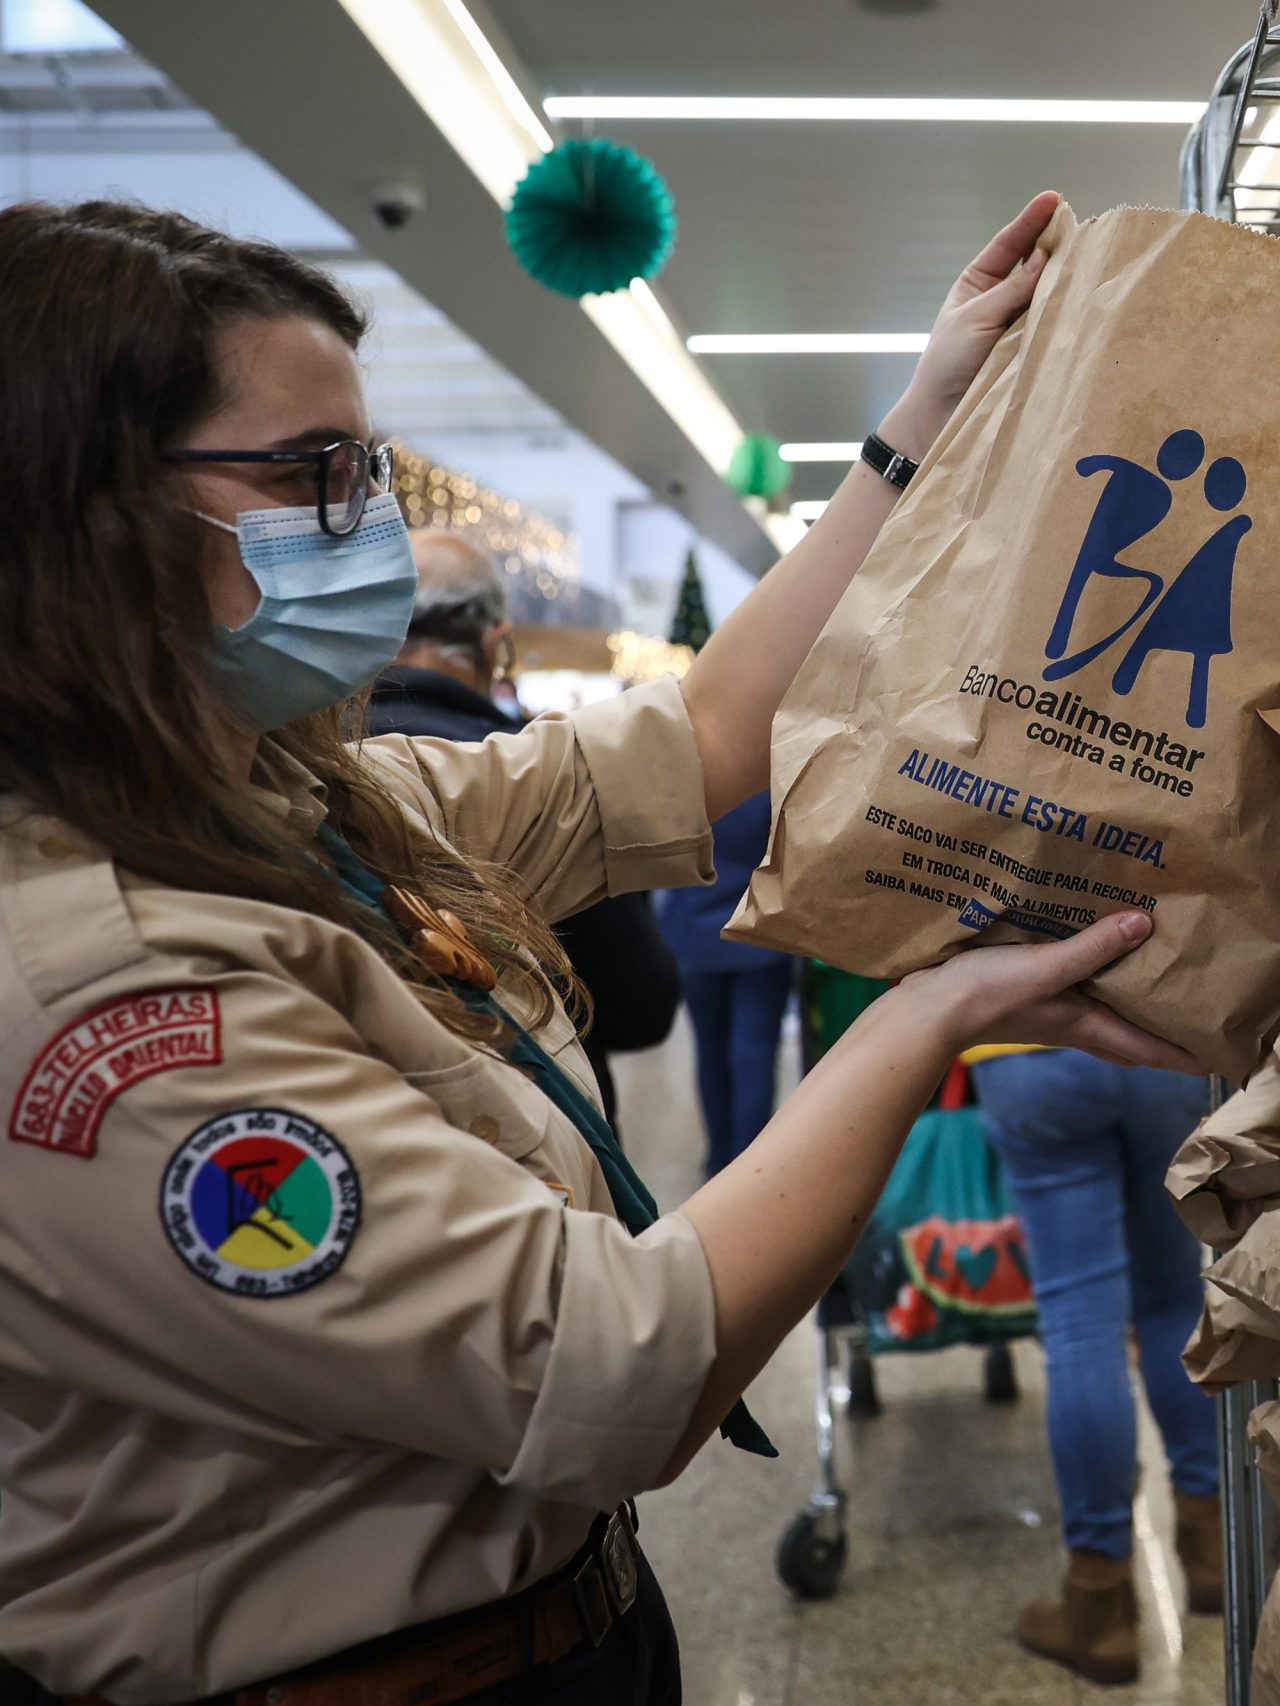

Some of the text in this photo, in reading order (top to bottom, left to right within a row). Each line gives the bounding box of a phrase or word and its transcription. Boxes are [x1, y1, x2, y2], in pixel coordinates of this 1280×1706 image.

[1026, 722, 1194, 797] contra a fome
[898, 748, 1167, 869] ALIMENTE ESTA IDEIA.
[864, 869, 906, 892] SAIBA
[909, 882, 944, 903] MAIS
[946, 892, 968, 912] EM
[865, 805, 1158, 913] ESTE SACO VAI SER ENTREGUE PARA RECICLAR
[902, 851, 1097, 925] EM TROCA DE MAIS ALIMENTOS
[107, 1031, 209, 1081] ORIENTAL
